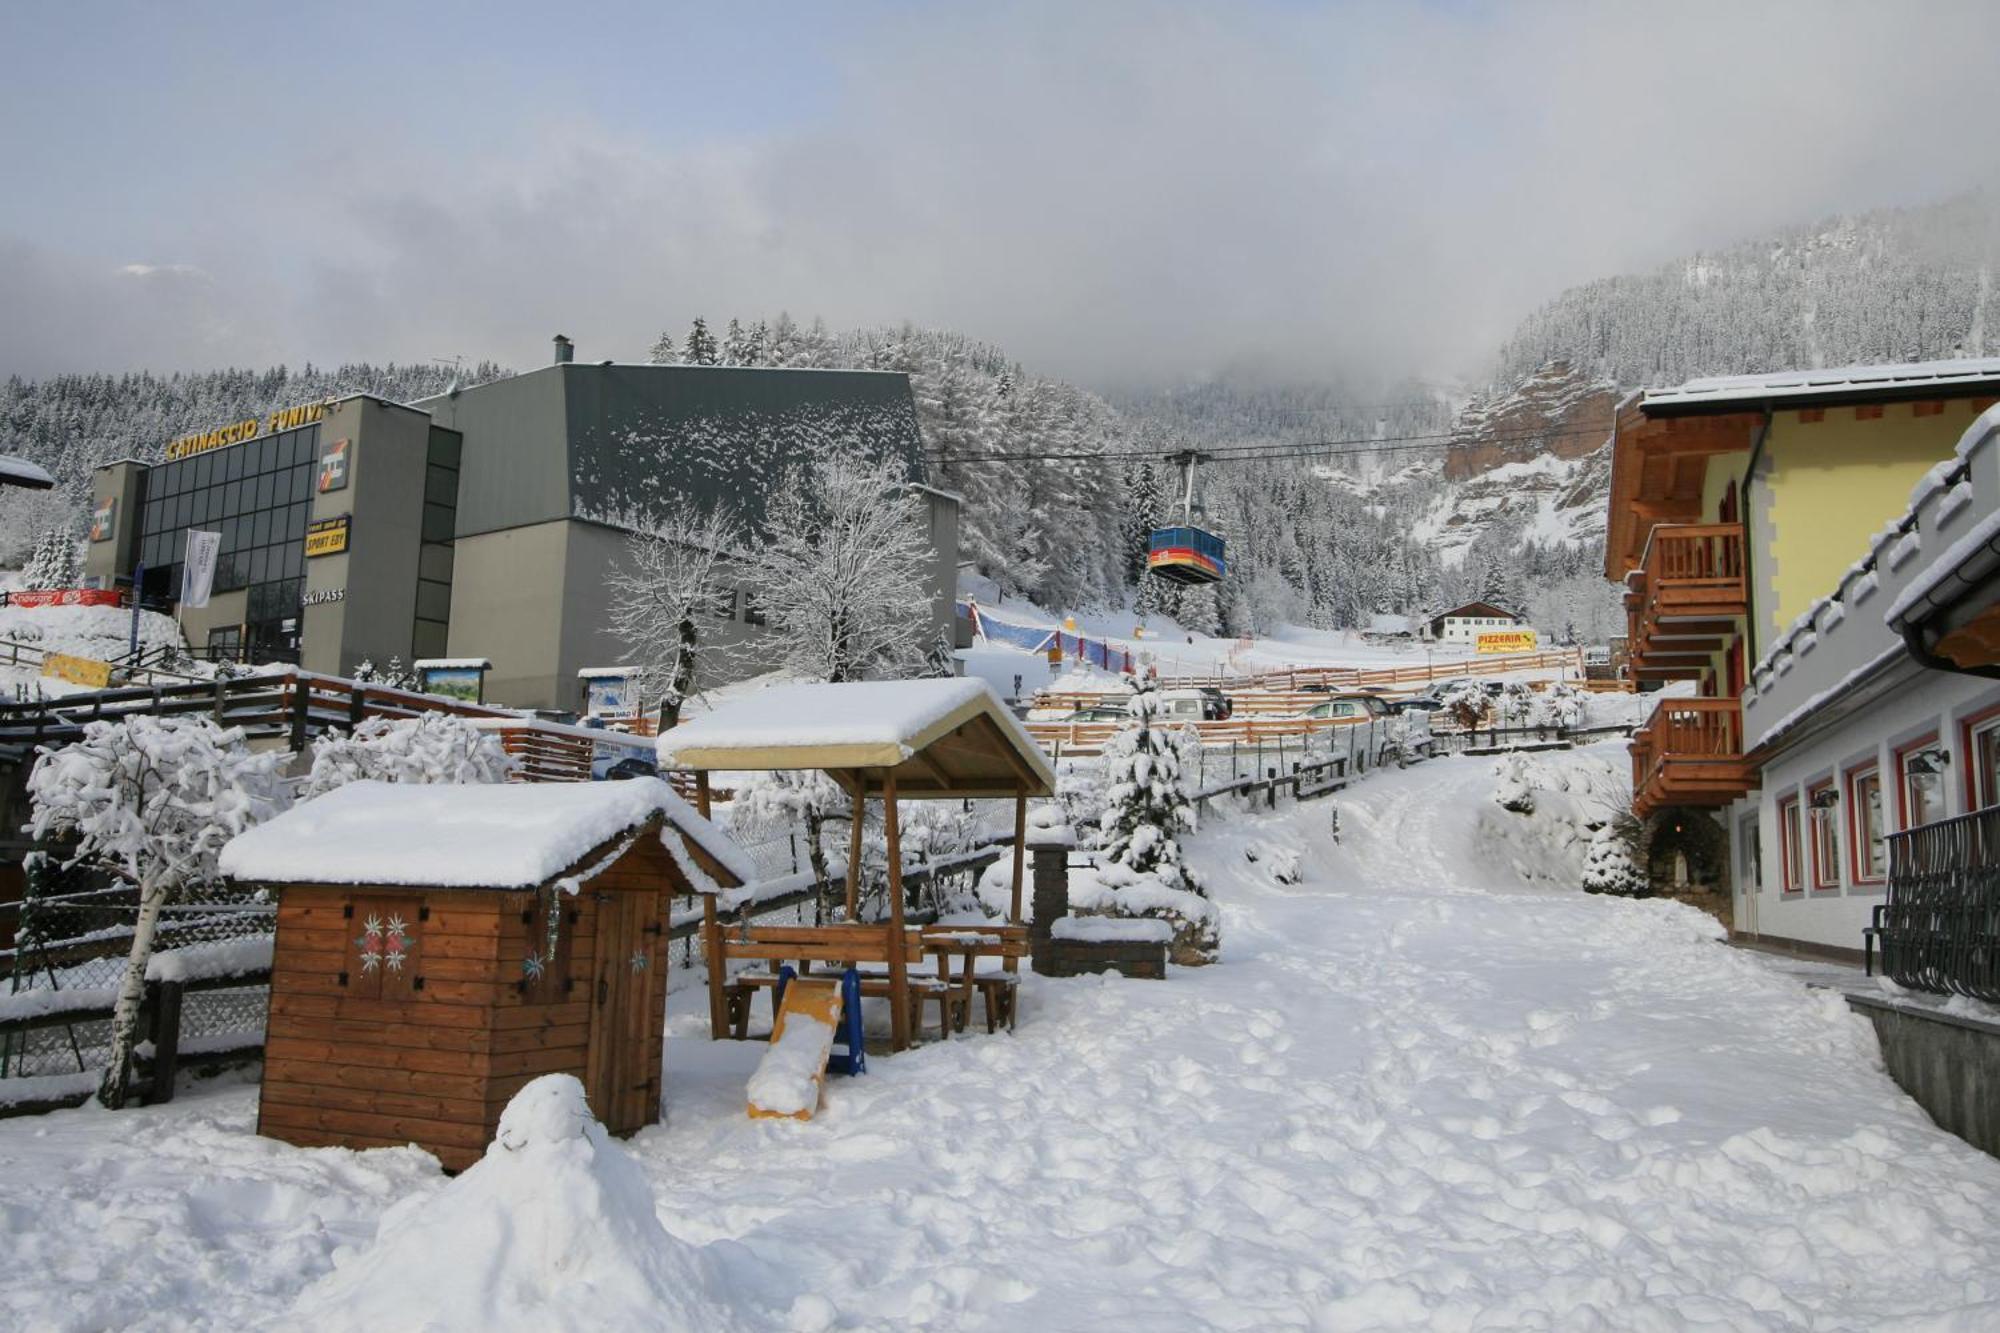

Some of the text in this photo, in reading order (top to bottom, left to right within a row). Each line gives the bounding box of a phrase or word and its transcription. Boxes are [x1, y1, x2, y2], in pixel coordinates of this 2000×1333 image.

[167, 419, 257, 460] CATINACCIO
[307, 536, 329, 551] SPORT
[302, 588, 344, 606] SKIPASS
[1478, 634, 1521, 643] PIZZERIA
